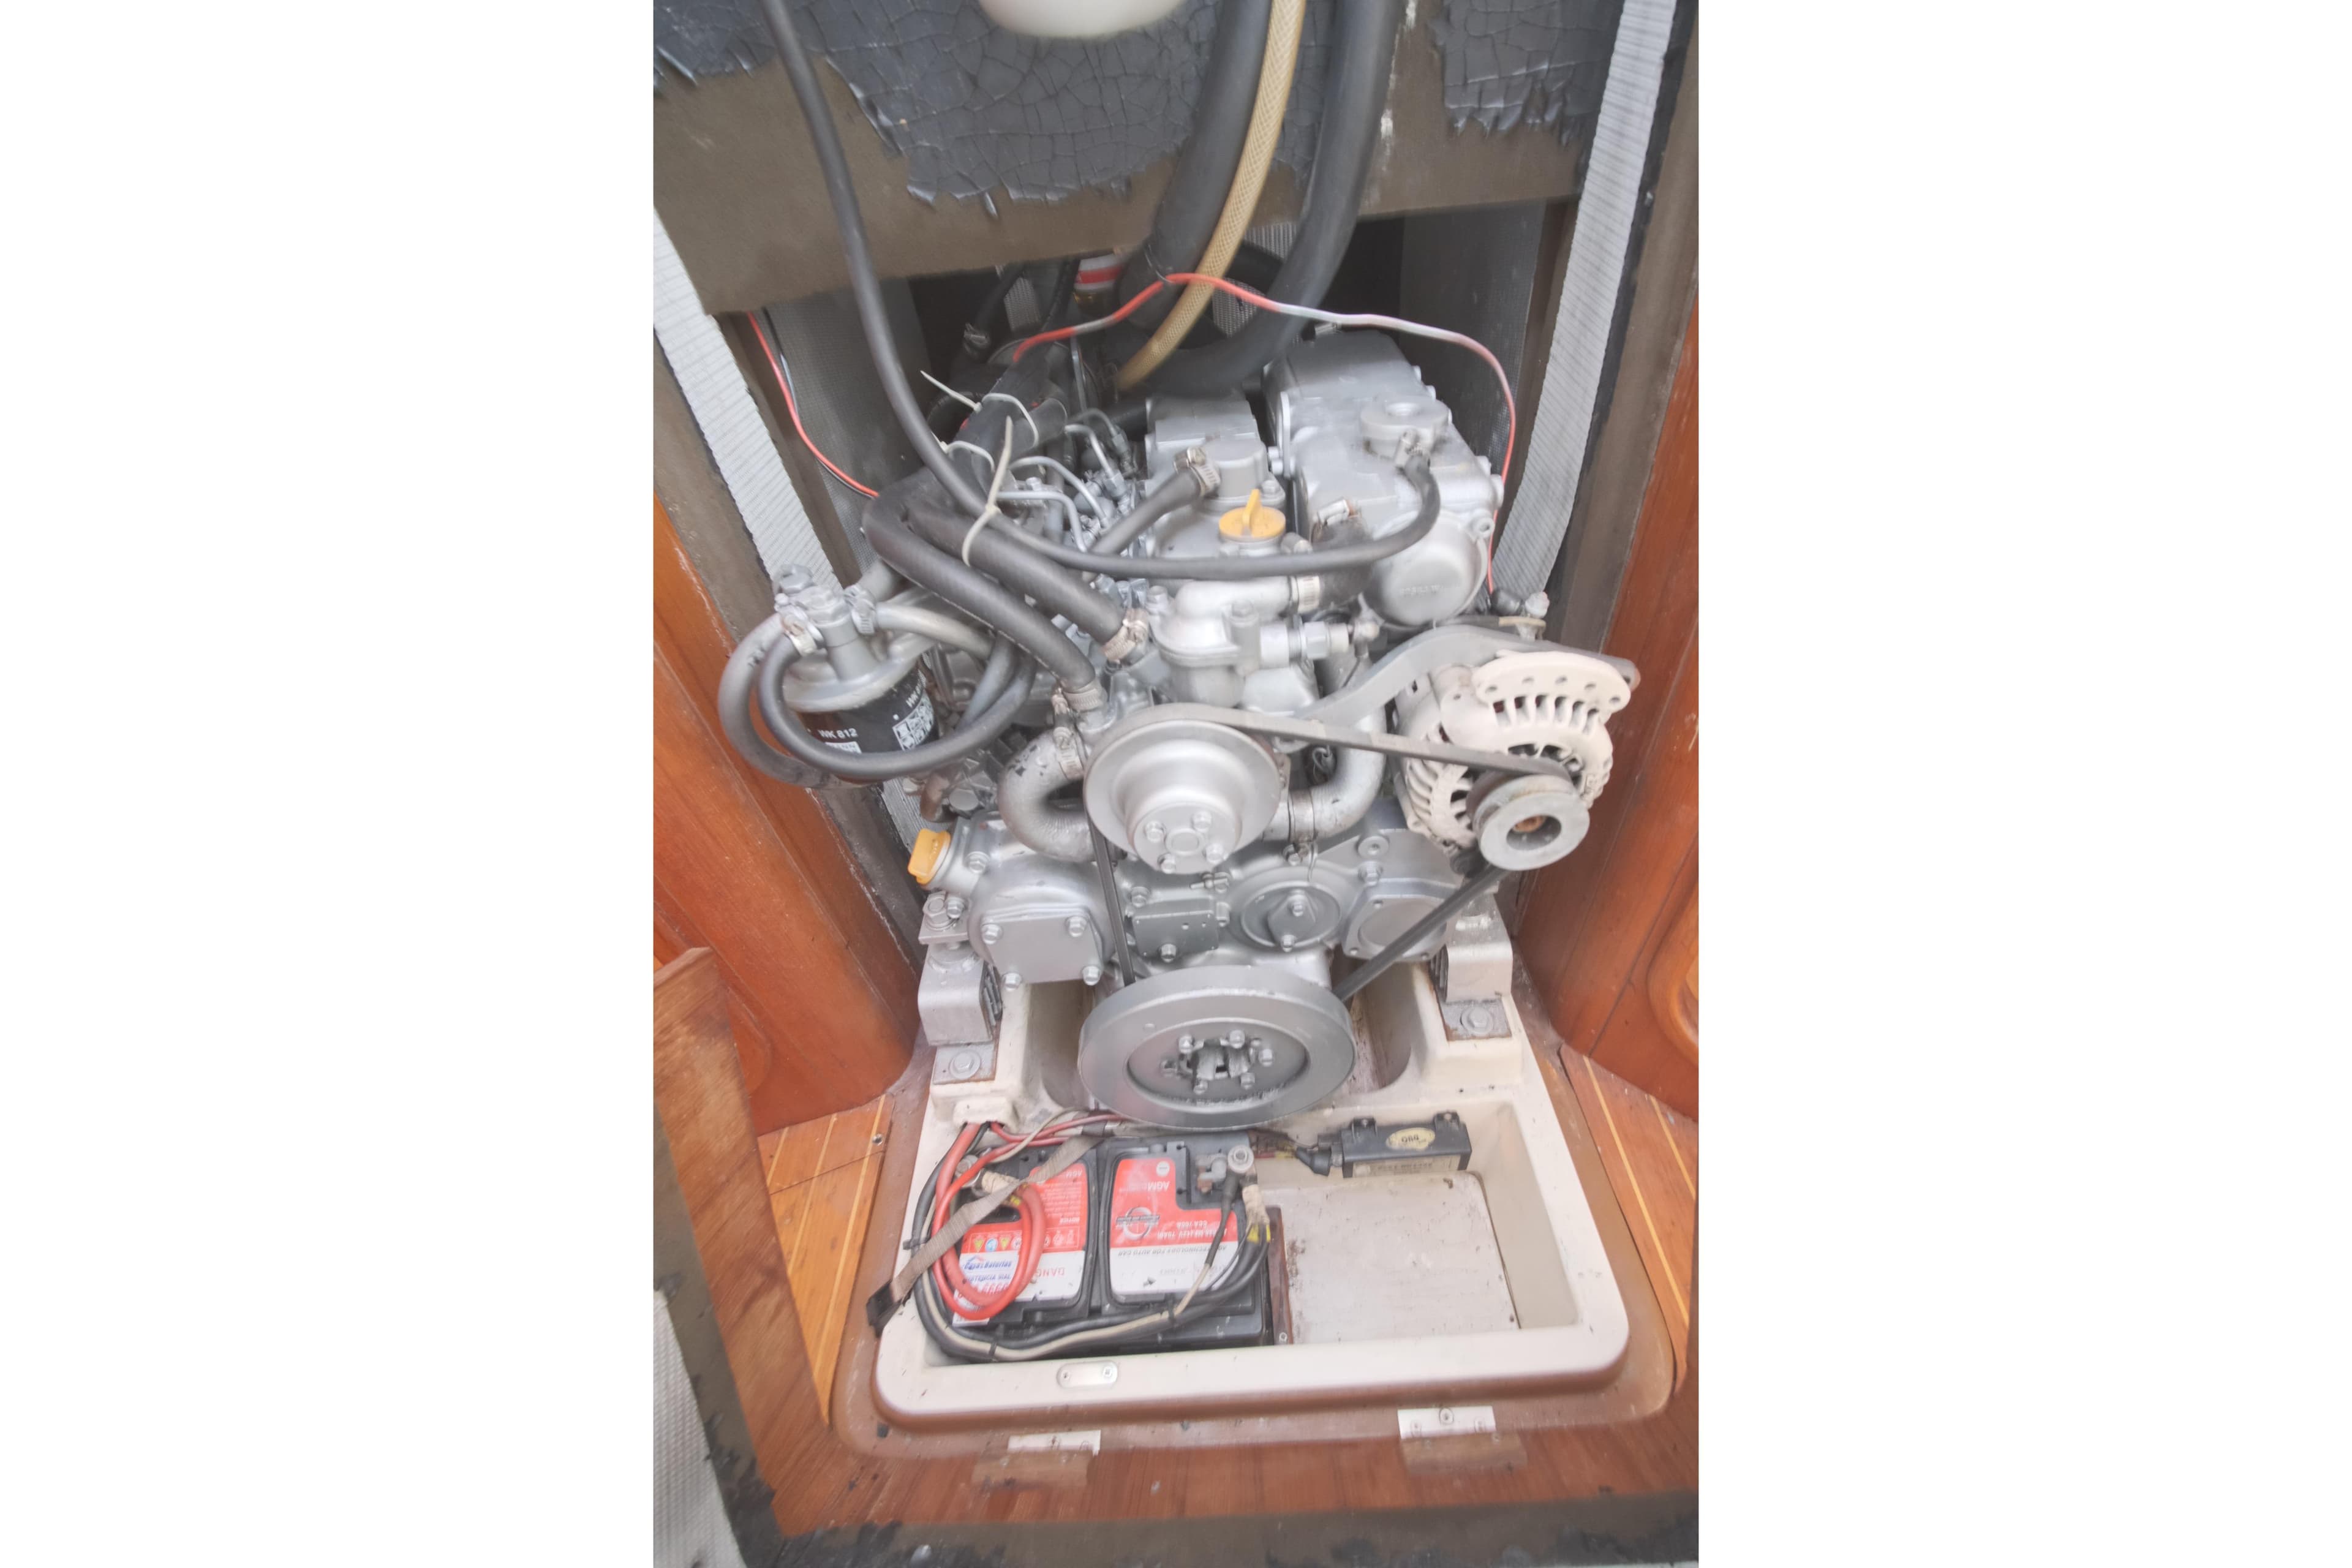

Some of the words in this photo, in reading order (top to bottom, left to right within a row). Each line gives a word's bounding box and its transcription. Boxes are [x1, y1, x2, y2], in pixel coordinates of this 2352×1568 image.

[818, 729, 837, 739] WK
[837, 728, 858, 739] 812
[1147, 1181, 1170, 1191] AGM
